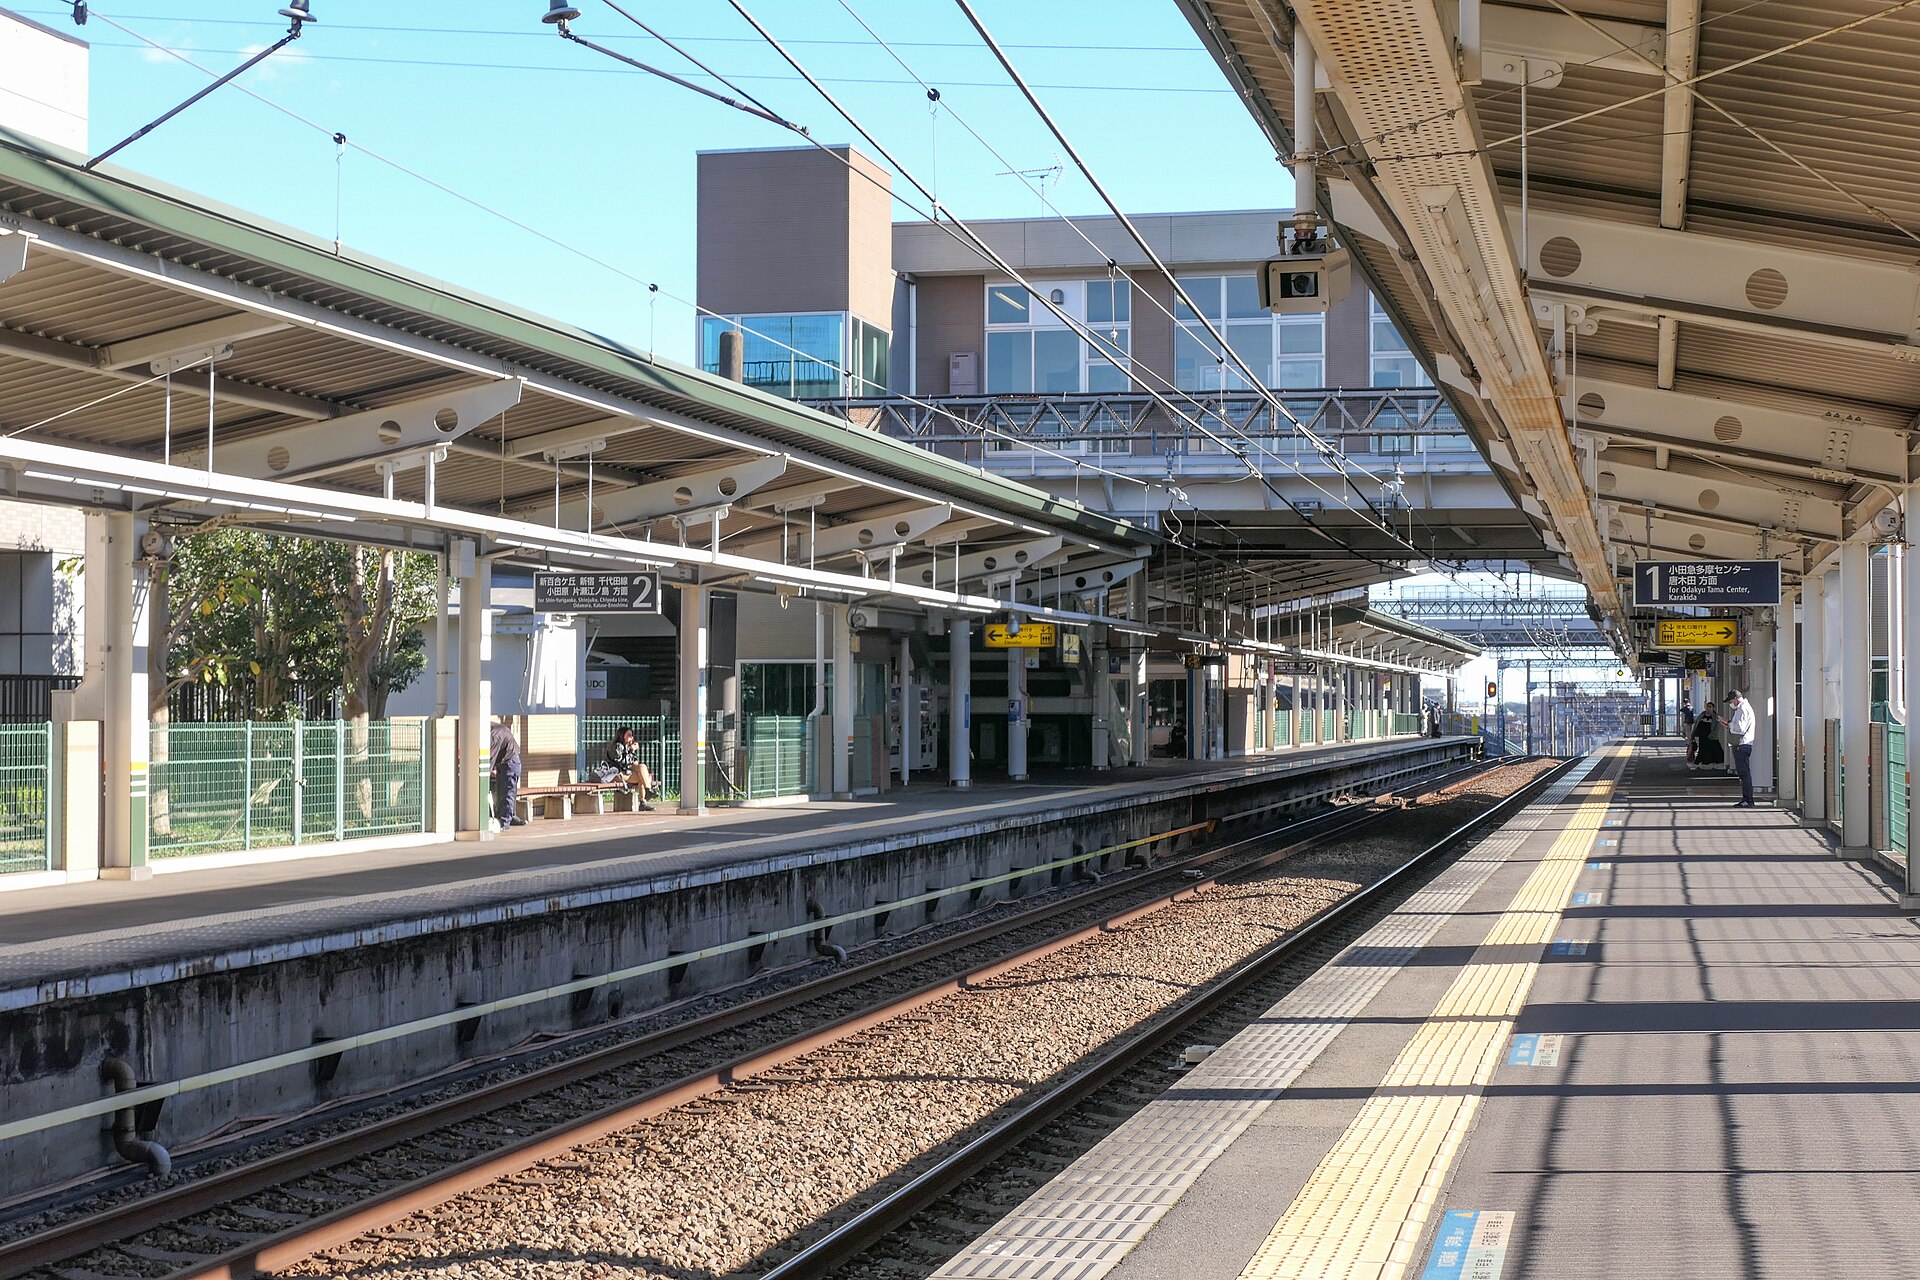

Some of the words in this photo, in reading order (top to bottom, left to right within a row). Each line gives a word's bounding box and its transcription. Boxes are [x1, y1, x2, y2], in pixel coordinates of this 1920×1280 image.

[1668, 565, 1750, 575] 小田急多摩センター
[539, 576, 576, 587] 新百合ケ丘
[580, 576, 595, 586] 新宿
[599, 576, 628, 586] 千代田線
[1645, 565, 1660, 601] 1
[1668, 575, 1697, 586] 唐木田
[1698, 575, 1718, 586] 方面
[546, 586, 569, 597] 小田原
[572, 586, 610, 596] 片瀬江ノ島
[613, 586, 628, 596] 方面
[632, 575, 652, 608] 2
[1681, 586, 1706, 595] Odakyu
[1726, 586, 1750, 594] Center,
[1308, 662, 1316, 674] 2
[1647, 667, 1653, 678] 1
